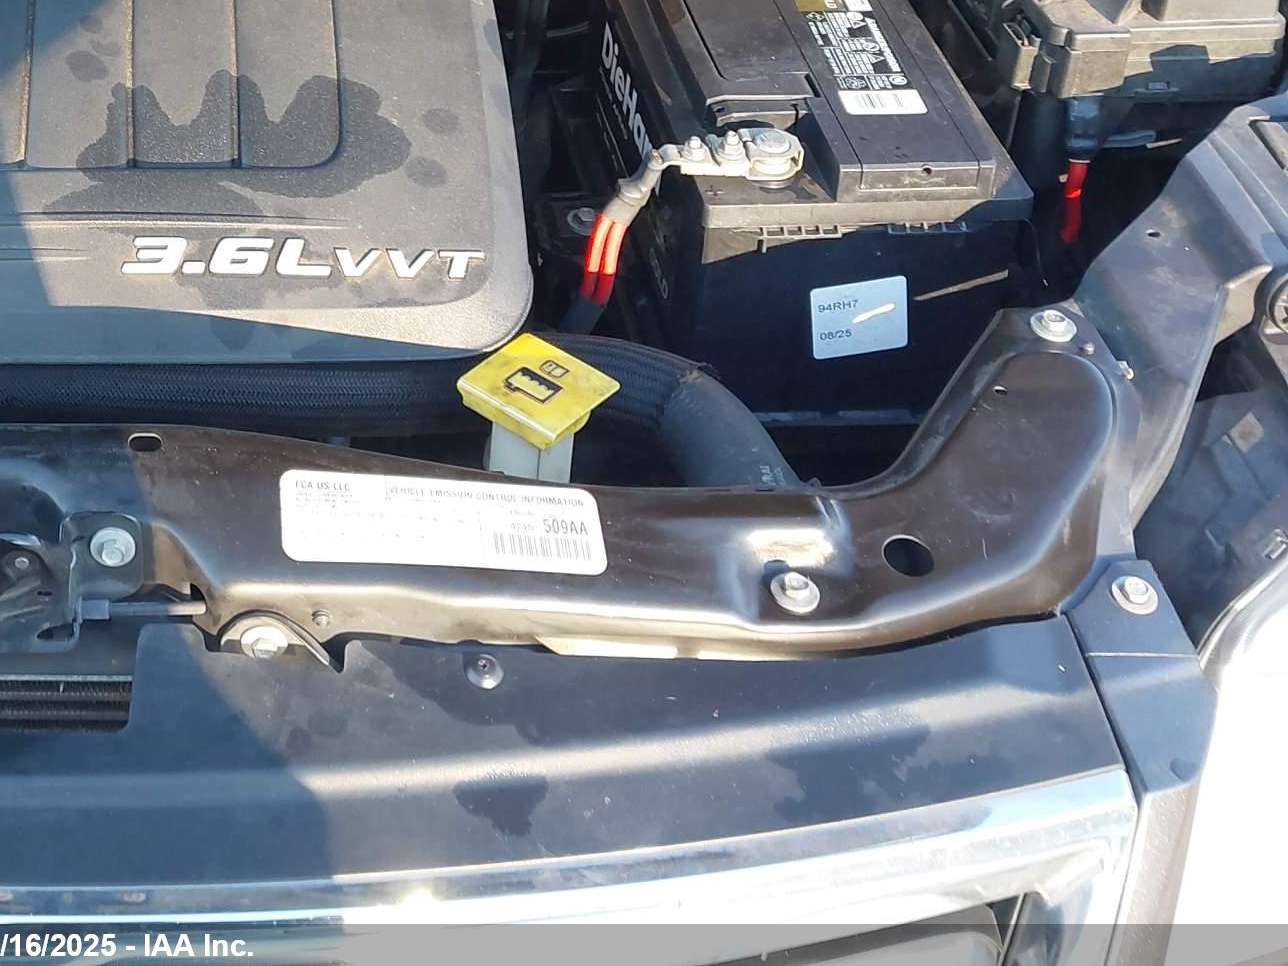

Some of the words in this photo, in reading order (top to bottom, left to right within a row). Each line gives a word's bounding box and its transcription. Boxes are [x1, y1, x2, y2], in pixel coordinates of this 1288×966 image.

[121, 236, 332, 278] 3.6L
[333, 247, 485, 280] VVT
[817, 299, 859, 313] 94RH7
[819, 328, 853, 341] 08/25
[542, 518, 589, 536] 509AA
